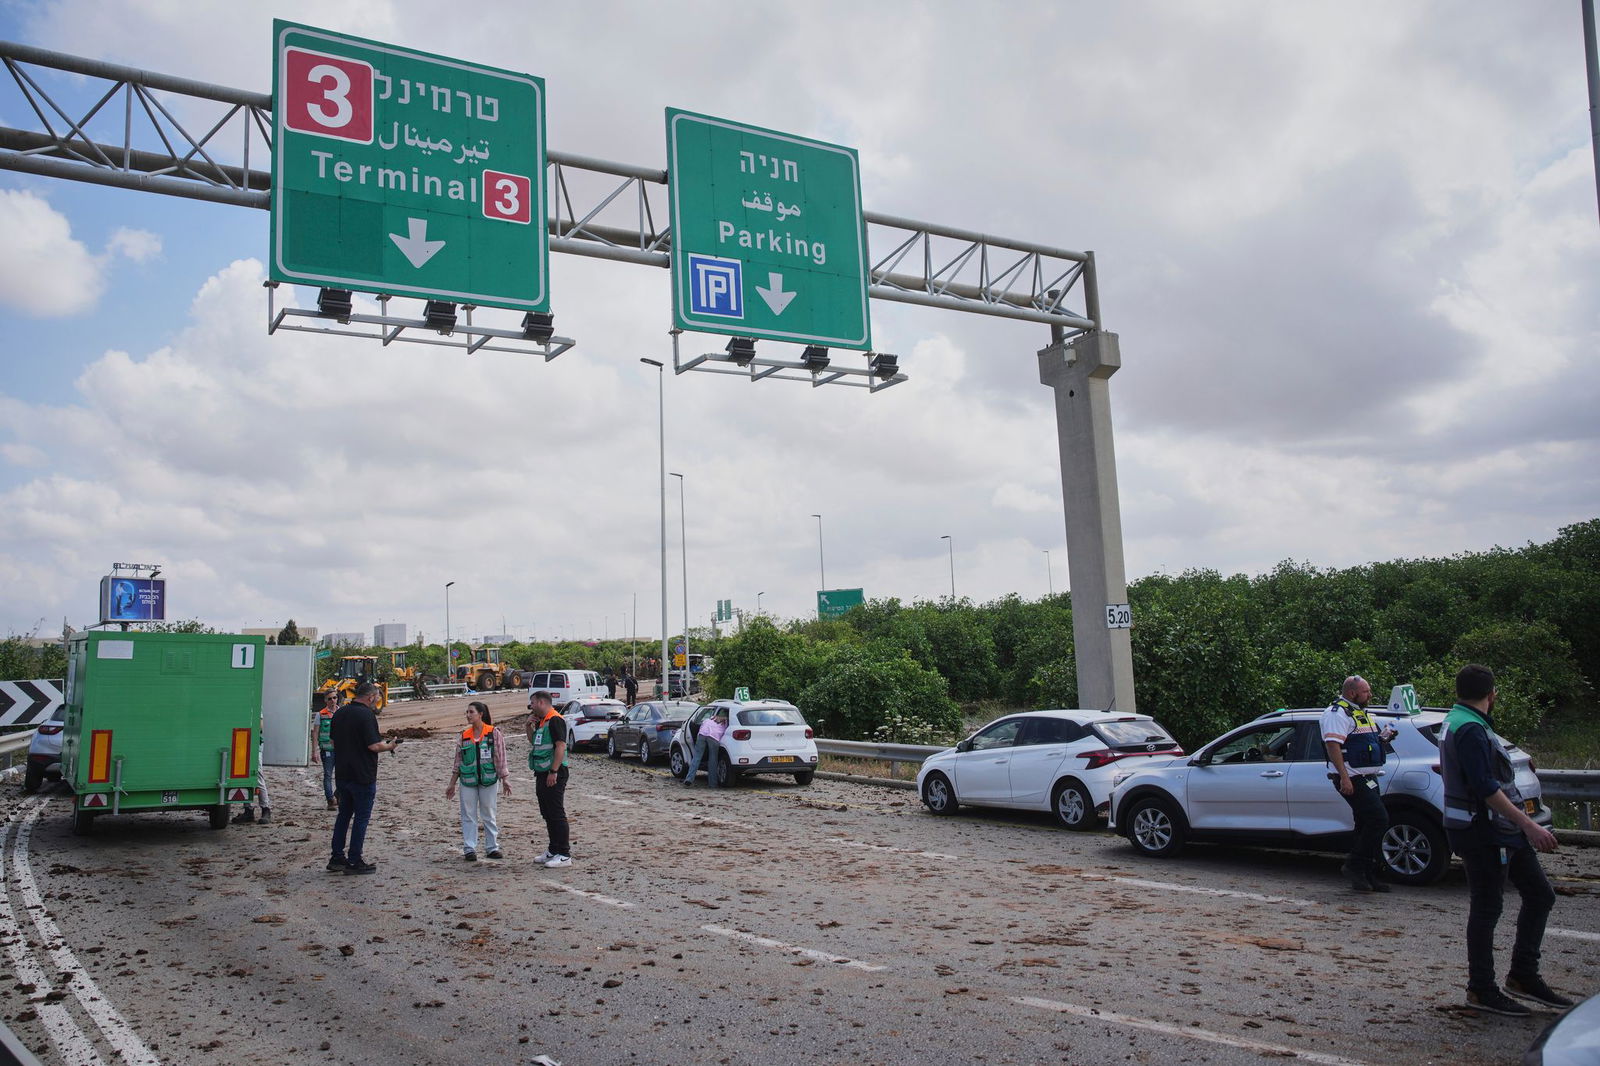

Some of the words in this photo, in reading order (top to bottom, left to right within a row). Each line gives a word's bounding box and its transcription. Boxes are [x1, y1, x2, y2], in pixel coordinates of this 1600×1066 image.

[306, 64, 353, 128] 3
[374, 69, 499, 122] טרמינל
[740, 150, 798, 183] חניה
[311, 150, 477, 203] Terminal
[494, 178, 520, 216] 3
[741, 190, 801, 222] موقف
[719, 220, 826, 265] Parking
[1108, 609, 1129, 624] 5.20
[240, 646, 247, 666] 1
[738, 689, 749, 699] 15
[1402, 689, 1419, 711] 12
